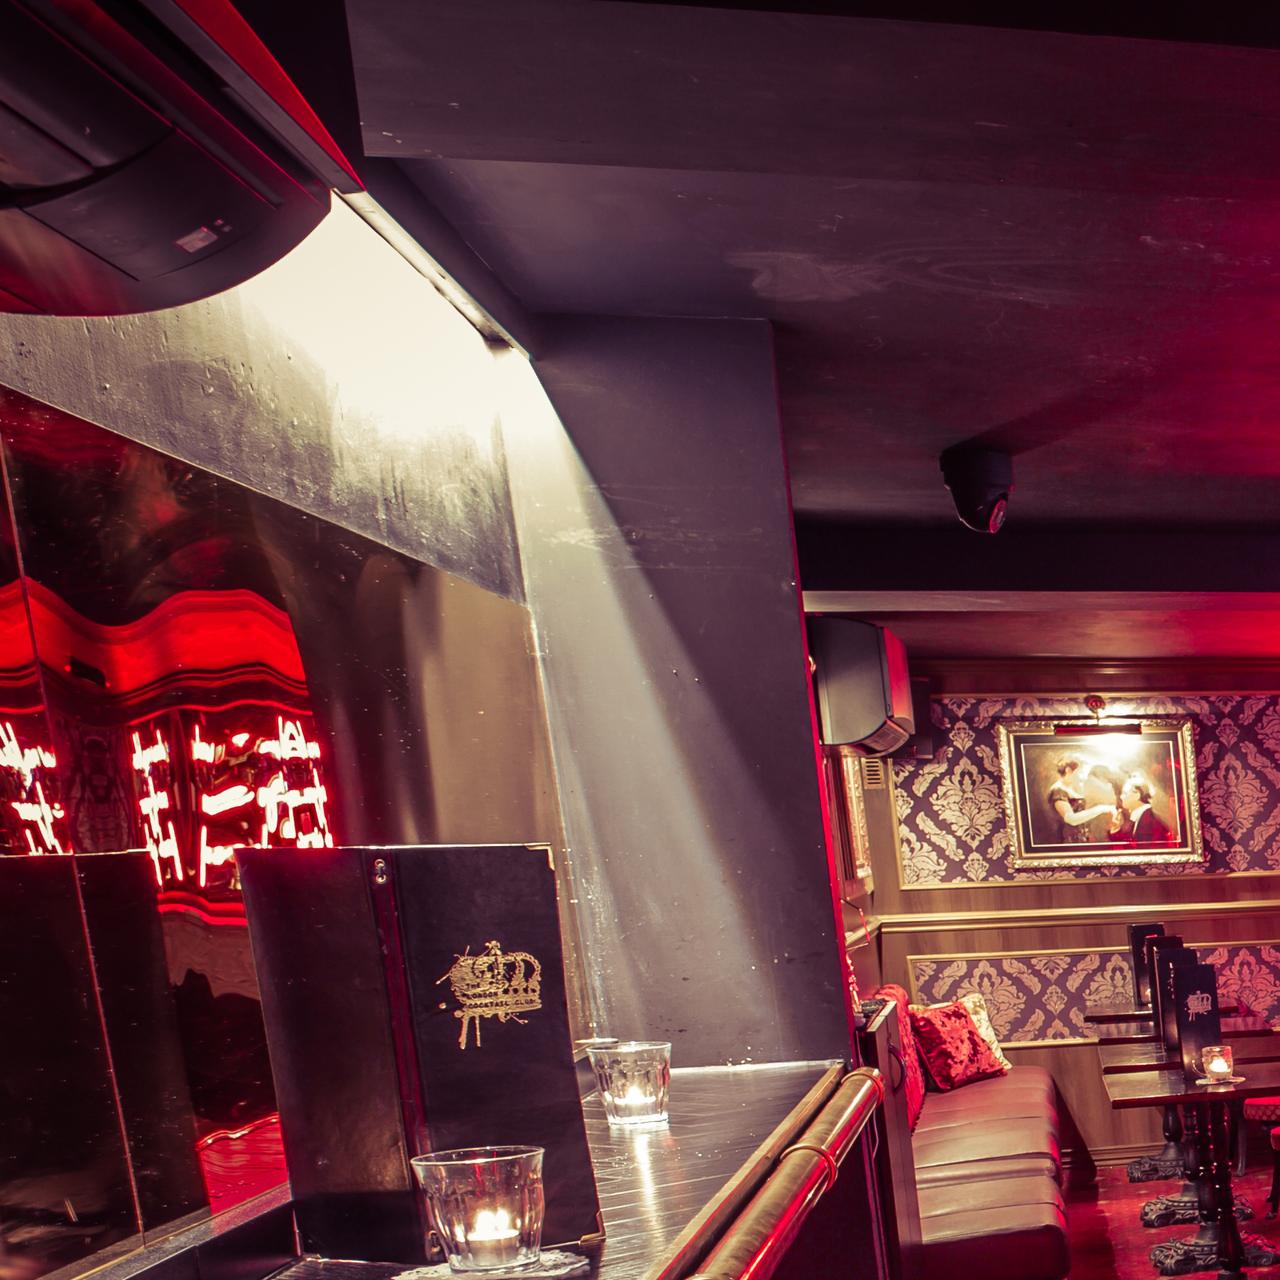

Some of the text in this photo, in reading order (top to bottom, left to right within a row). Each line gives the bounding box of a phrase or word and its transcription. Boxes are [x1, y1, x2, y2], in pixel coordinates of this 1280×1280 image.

[466, 991, 499, 999] LONDON
[468, 998, 536, 1009] COCKTAIL CLUB
